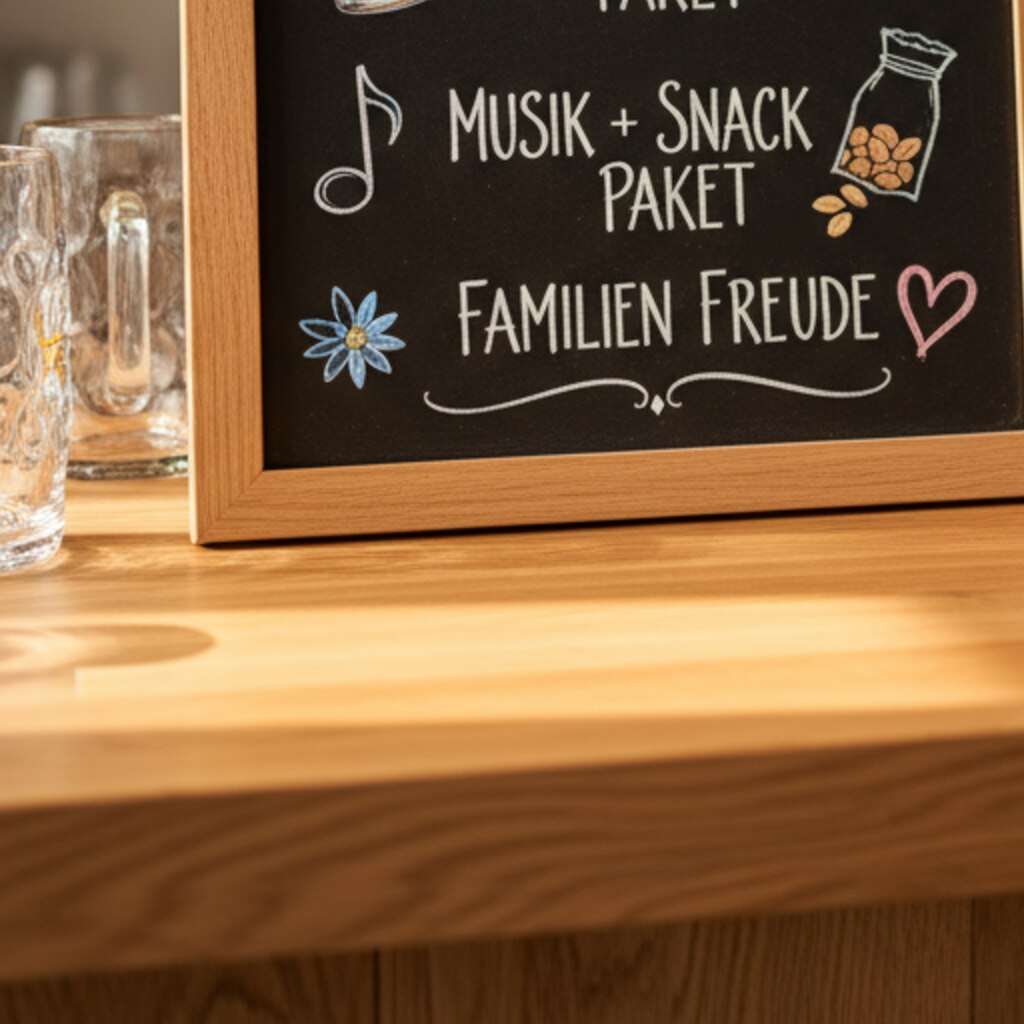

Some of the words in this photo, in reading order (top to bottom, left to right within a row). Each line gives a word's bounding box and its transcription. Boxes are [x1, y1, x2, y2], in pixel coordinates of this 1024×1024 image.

[448, 86, 596, 163] MUSIK
[610, 107, 638, 137] +
[657, 80, 813, 155] SNACK
[599, 161, 755, 233] PAKET
[458, 279, 673, 357] FAMILIEN
[700, 269, 880, 346] FREUDE
